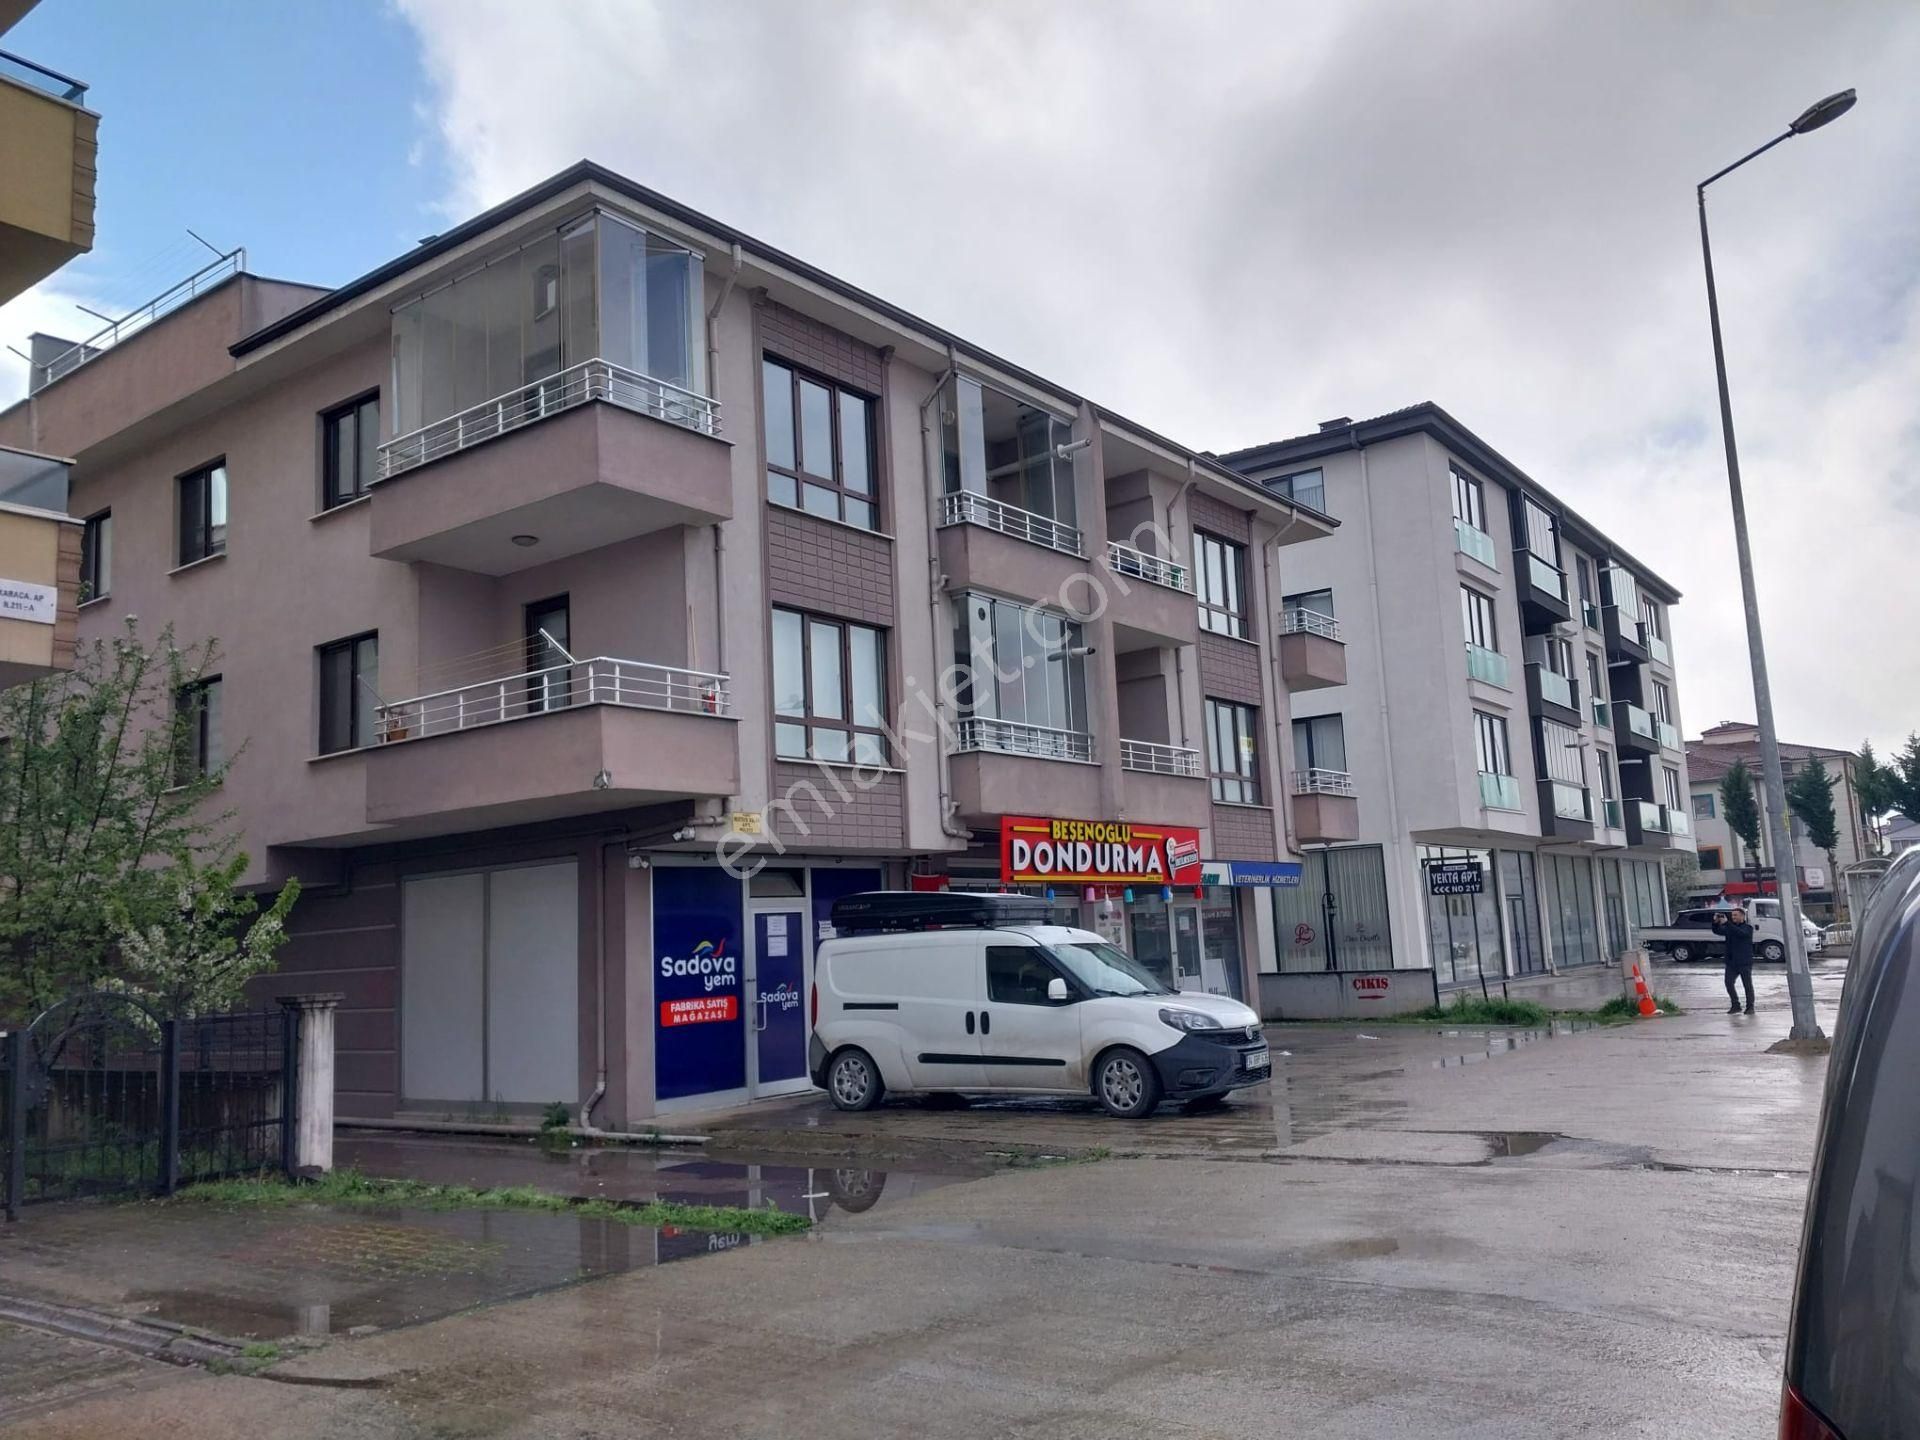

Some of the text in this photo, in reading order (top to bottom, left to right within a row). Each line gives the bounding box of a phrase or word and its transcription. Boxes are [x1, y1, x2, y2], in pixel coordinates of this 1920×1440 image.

[1012, 838, 1163, 874] DONDURMA
[1431, 871, 1481, 885] YEKTA APT.
[661, 955, 735, 977] Sadova
[705, 975, 736, 991] yem
[760, 991, 799, 1003] Sadova
[781, 1000, 799, 1011] yem
